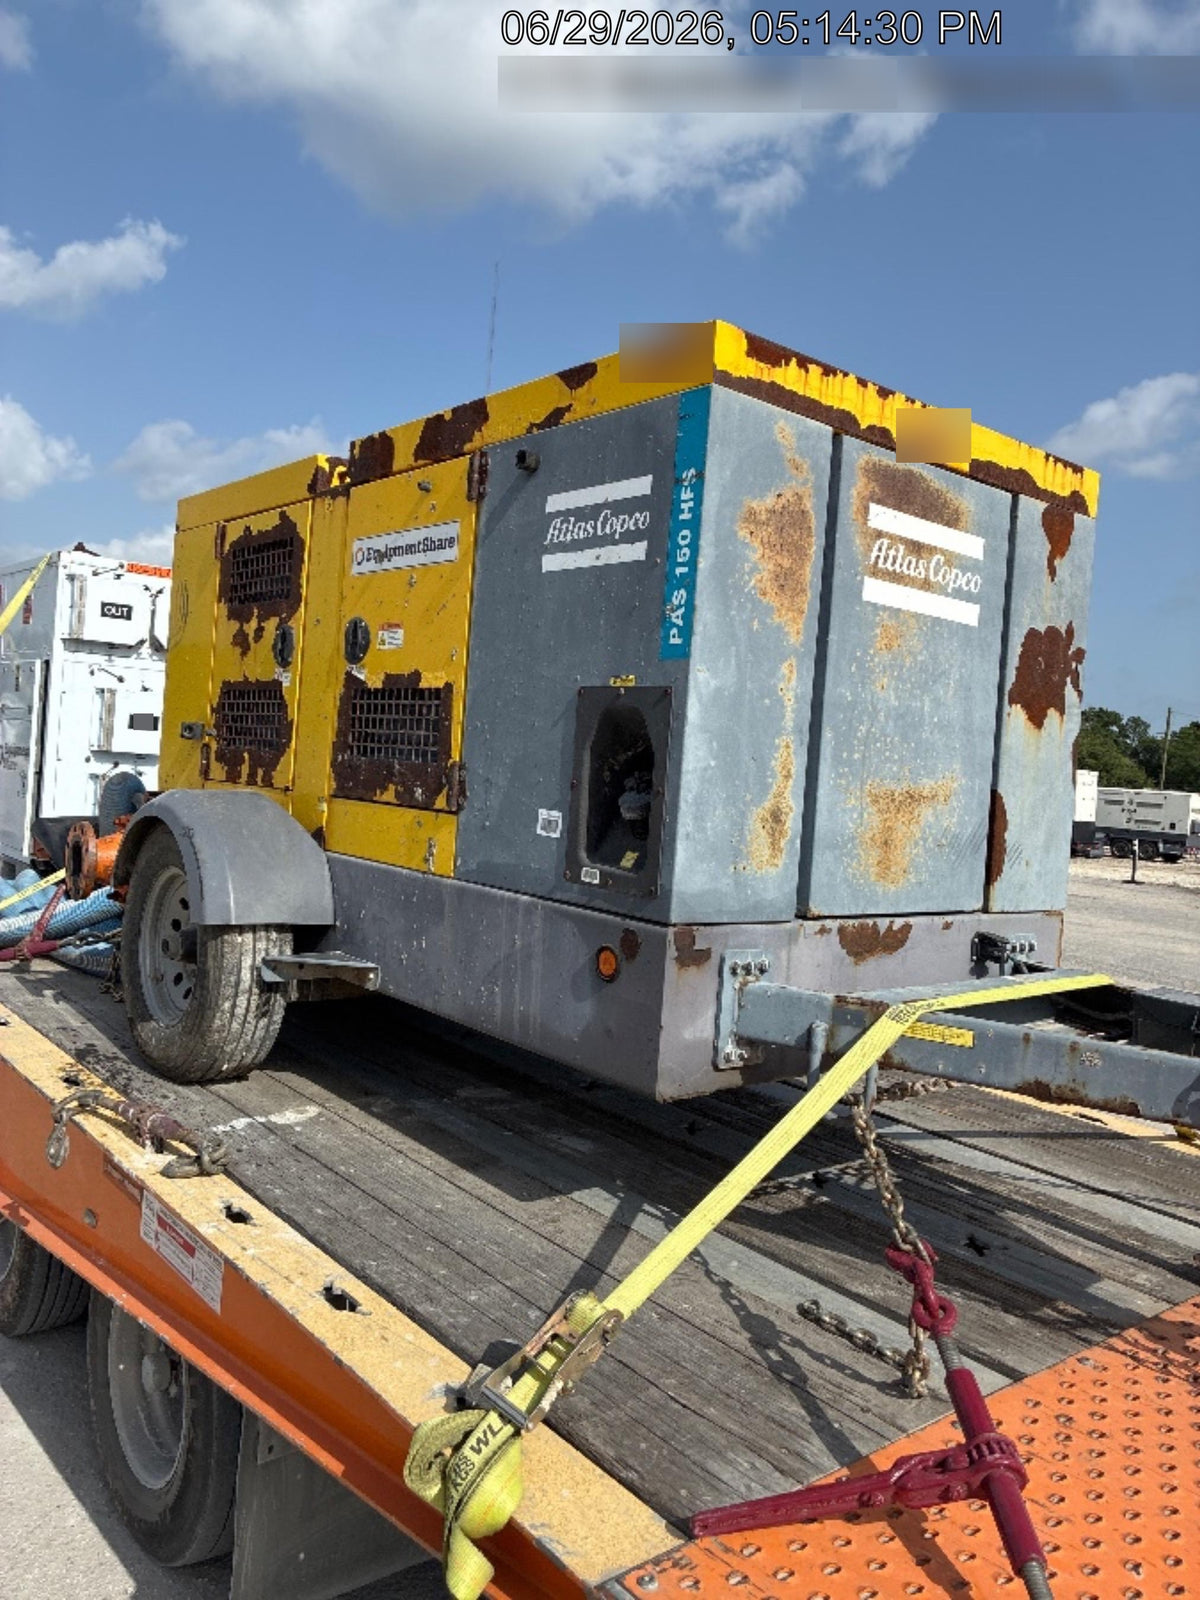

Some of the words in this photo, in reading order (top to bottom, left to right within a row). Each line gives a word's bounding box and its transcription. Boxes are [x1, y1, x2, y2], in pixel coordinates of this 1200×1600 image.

[678, 466, 696, 521] HFS
[543, 516, 595, 545] Atlas
[597, 510, 650, 539] Copco
[674, 529, 692, 577] 150
[866, 538, 927, 579] Atlas
[929, 554, 982, 593] Copco
[104, 605, 129, 617] OUT
[668, 587, 687, 645] PAS
